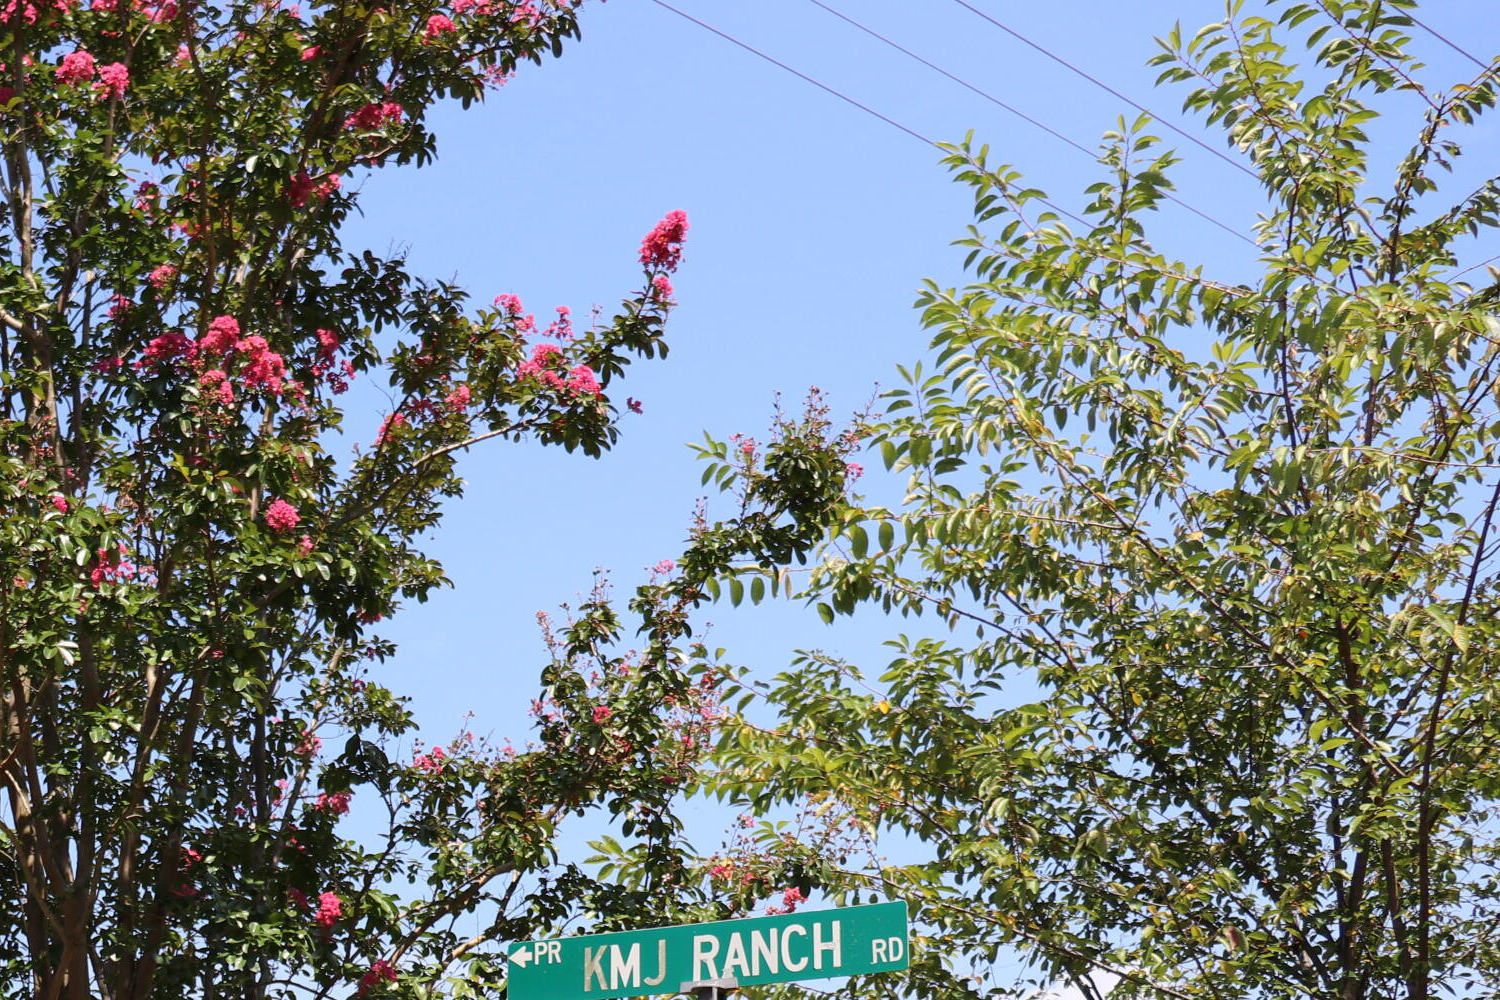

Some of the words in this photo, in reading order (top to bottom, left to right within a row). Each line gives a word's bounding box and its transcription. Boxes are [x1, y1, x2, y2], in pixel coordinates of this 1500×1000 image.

[534, 941, 562, 965] PR
[583, 938, 667, 992] KMJ
[693, 920, 842, 982] RANCH
[871, 936, 905, 965] RD
